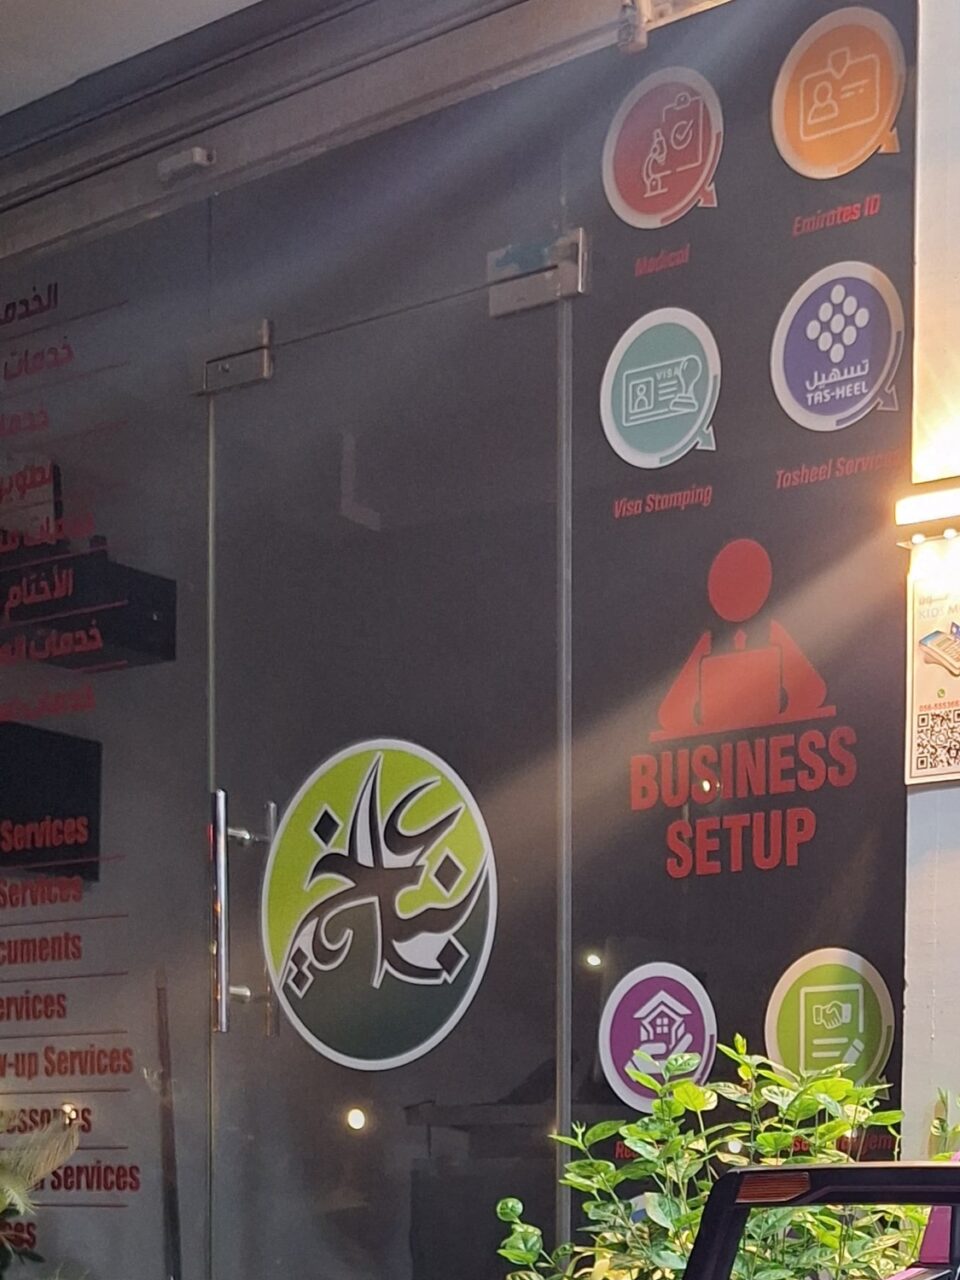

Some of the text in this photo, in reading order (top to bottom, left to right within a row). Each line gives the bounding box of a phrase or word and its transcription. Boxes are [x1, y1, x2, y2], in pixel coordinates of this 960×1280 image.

[793, 193, 881, 238] Emirates ID
[635, 243, 690, 276] Medical
[805, 359, 869, 391] تسهيل
[806, 381, 868, 406] TAS-HEEL
[776, 459, 833, 489] Tasheel
[614, 485, 712, 519] Visa Stamping
[630, 726, 858, 811] BUSINESS
[1, 816, 89, 852] Services
[665, 807, 817, 879] SETUP
[0, 874, 83, 910] Services
[0, 931, 82, 967] cuments
[0, 989, 66, 1021] ervices
[44, 1044, 134, 1078] Services
[51, 1161, 141, 1193] Services
